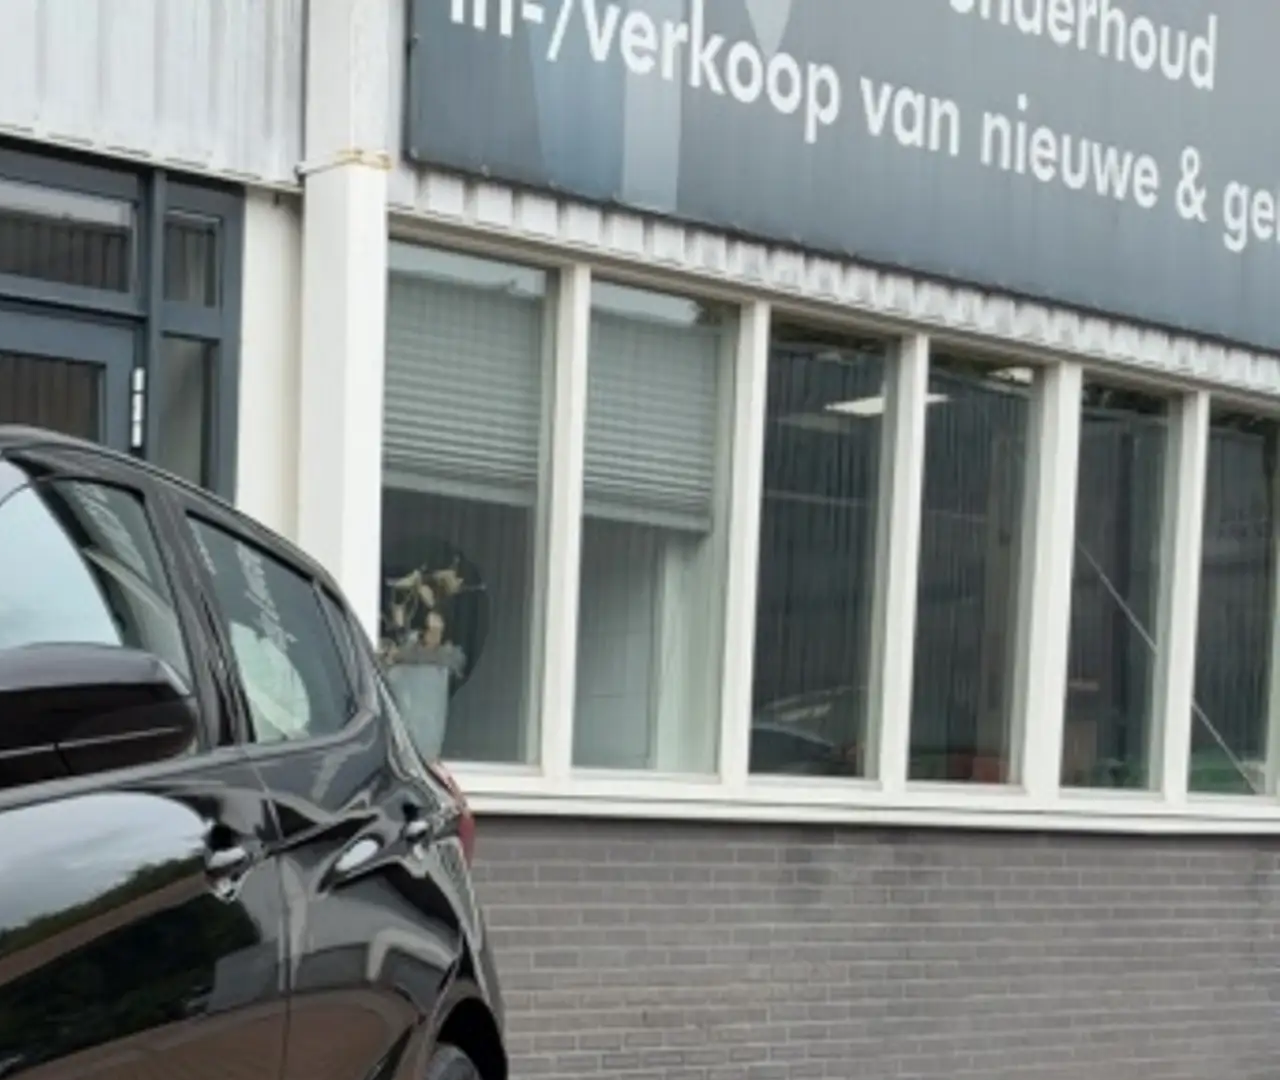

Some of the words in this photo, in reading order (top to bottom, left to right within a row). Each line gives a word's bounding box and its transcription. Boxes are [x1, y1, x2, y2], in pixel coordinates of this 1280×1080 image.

[860, 76, 960, 157] van
[980, 93, 1161, 209] nieuwe
[1175, 146, 1208, 222] &
[1223, 180, 1280, 253] ge
